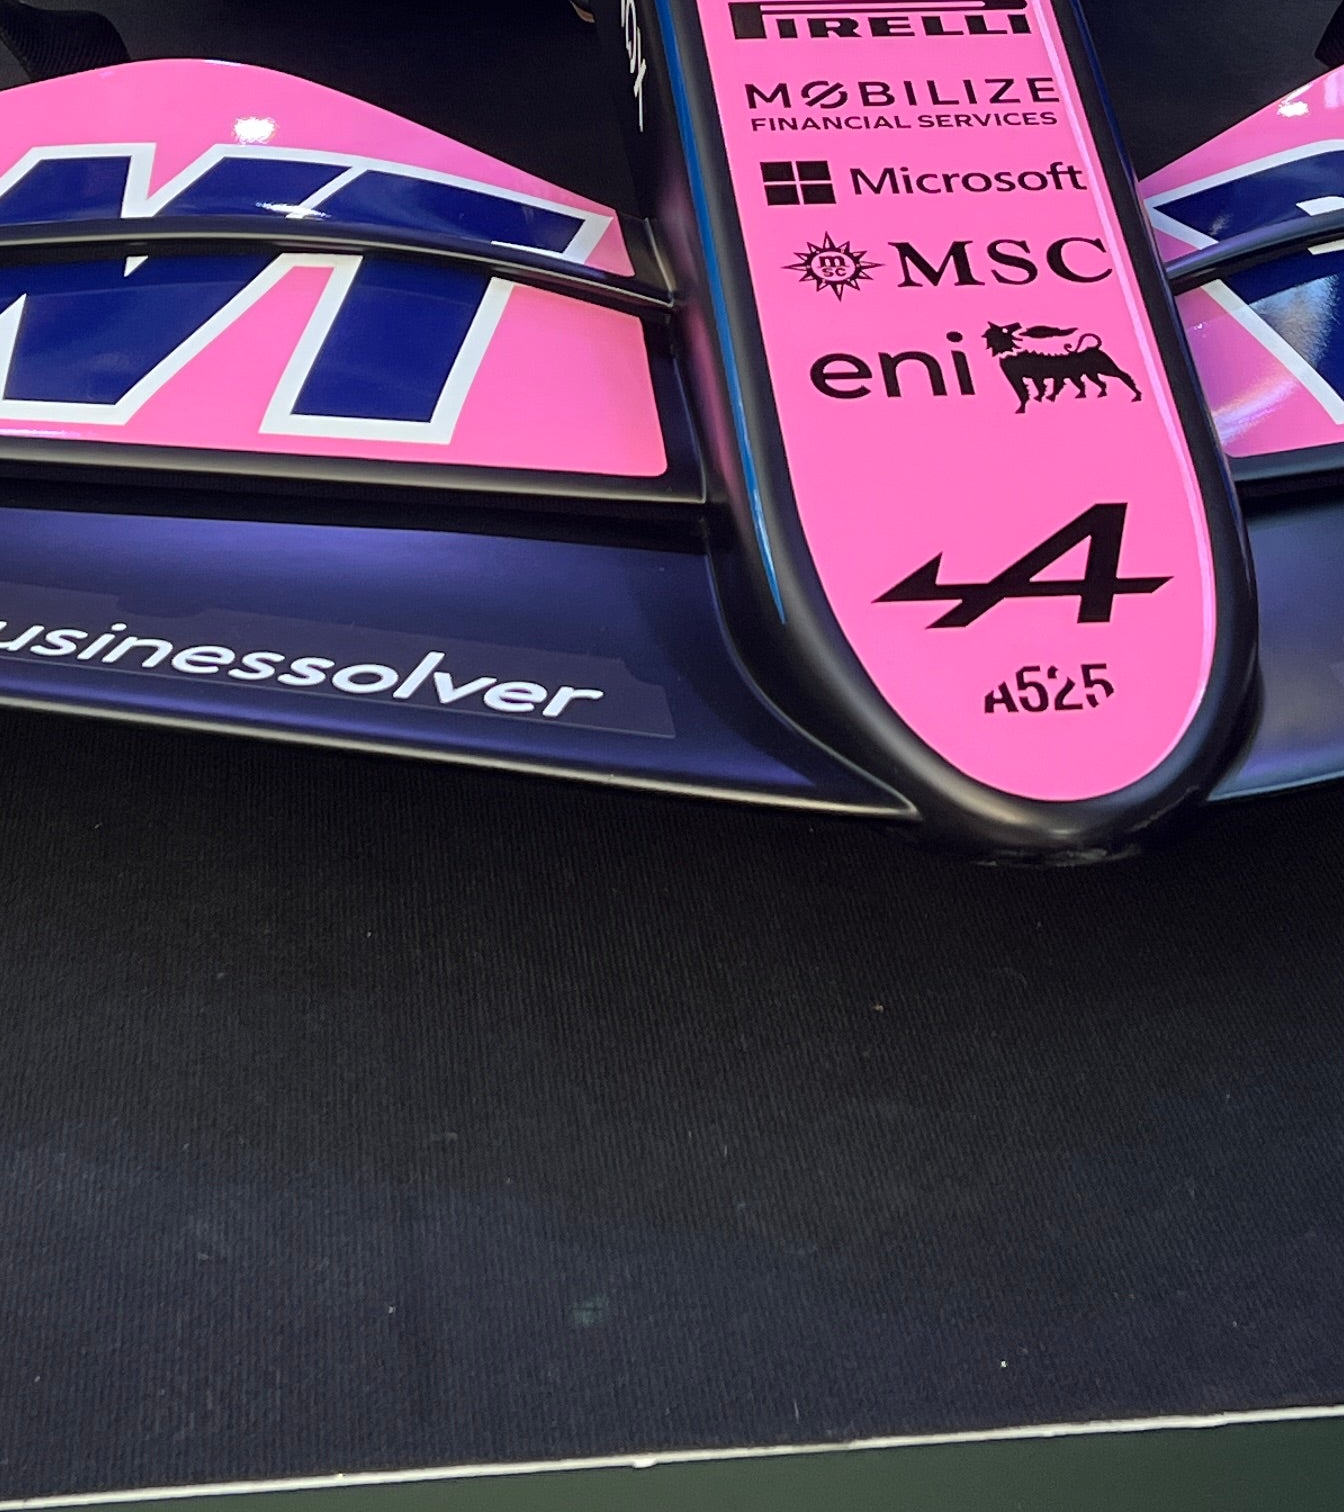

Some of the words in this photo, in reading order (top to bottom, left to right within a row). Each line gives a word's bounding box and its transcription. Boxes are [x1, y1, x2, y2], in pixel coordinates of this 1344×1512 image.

[751, 115, 912, 132] FINANCIAL
[918, 111, 1058, 129] SERVICES
[849, 161, 1088, 196] Microsoft
[888, 237, 1113, 288] MSC
[809, 331, 977, 400] eni
[984, 663, 1115, 715] A525
